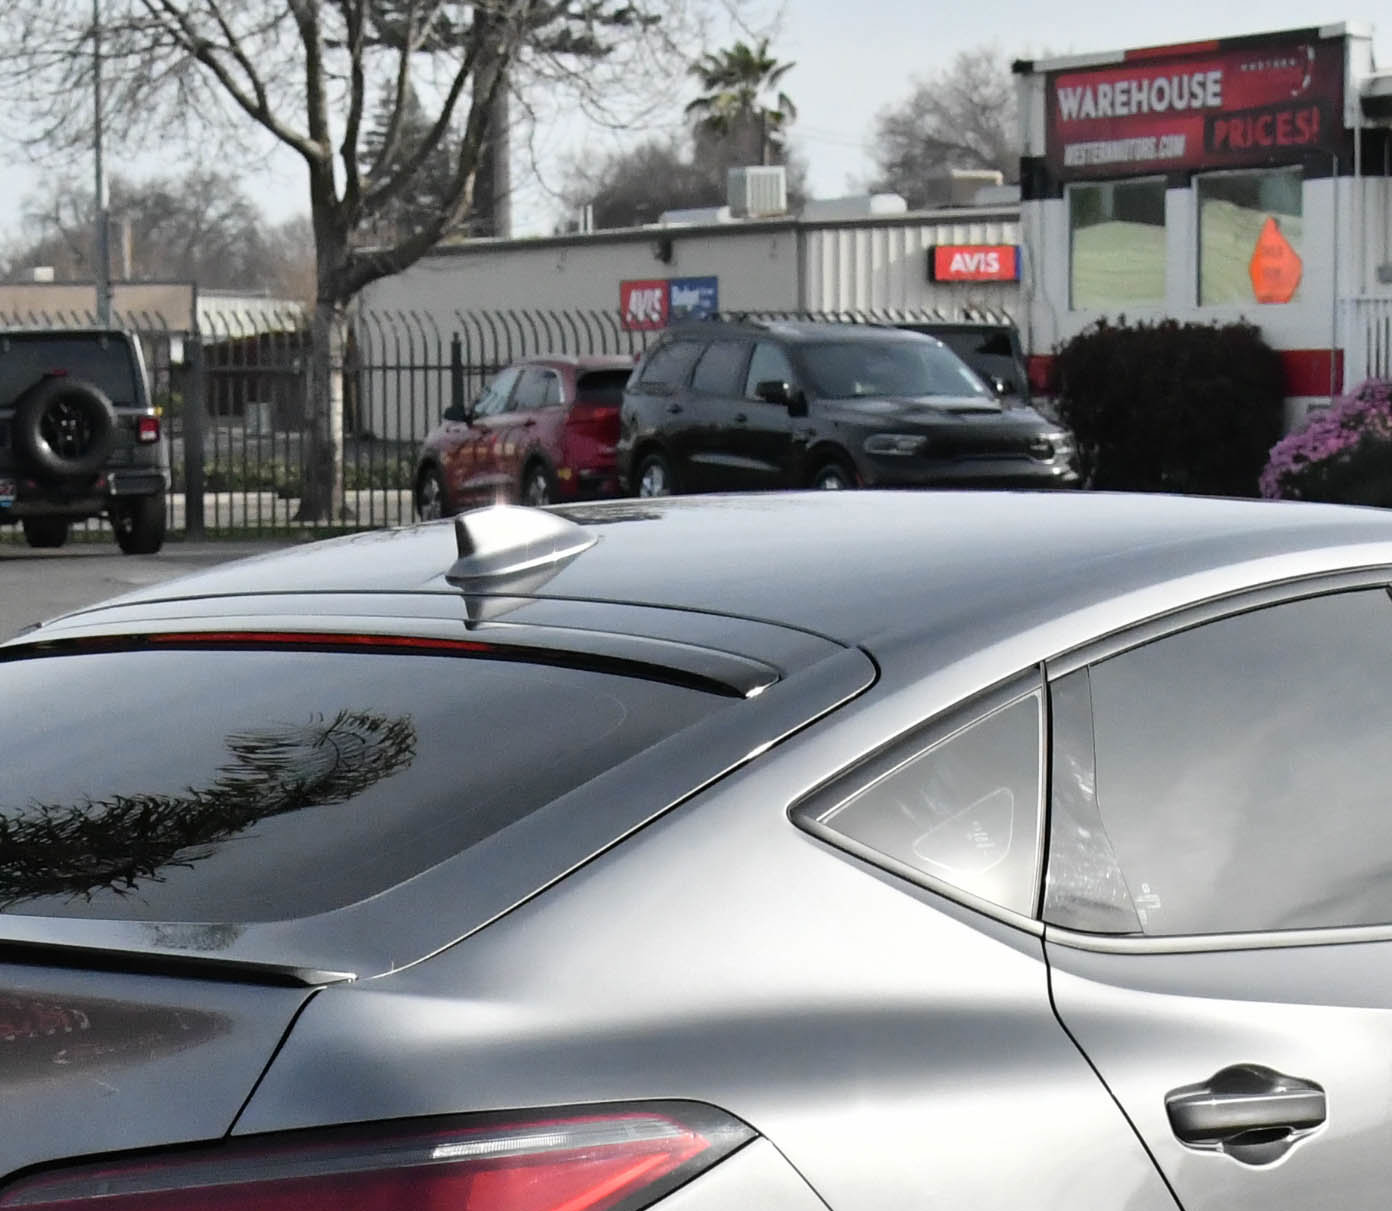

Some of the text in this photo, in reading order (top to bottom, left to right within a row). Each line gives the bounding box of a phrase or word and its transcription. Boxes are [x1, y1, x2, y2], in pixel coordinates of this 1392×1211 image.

[1058, 70, 1223, 121] WAREHOUSE
[1214, 105, 1320, 149] PRICES!
[950, 252, 1000, 273] AVIS
[626, 287, 662, 322] AVIS
